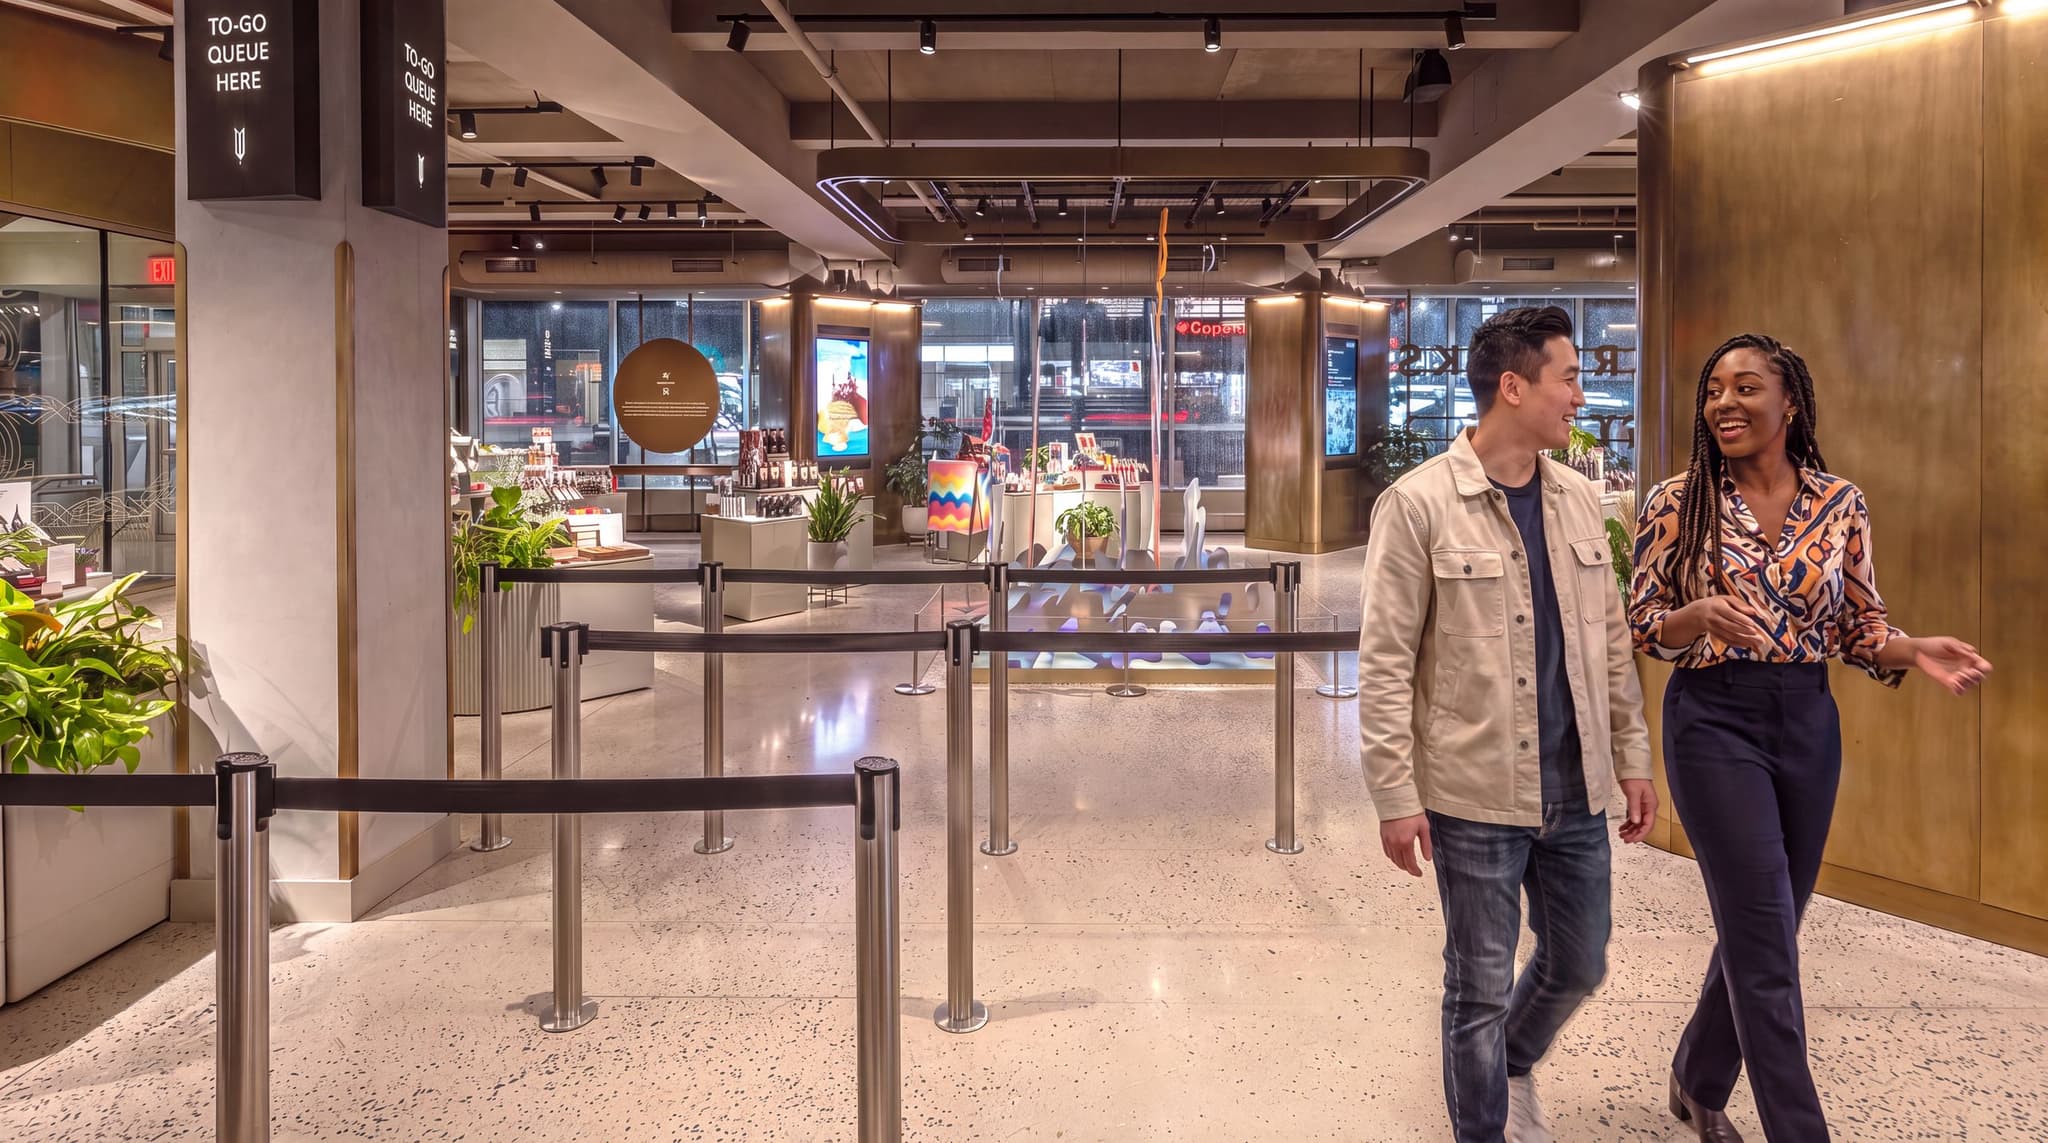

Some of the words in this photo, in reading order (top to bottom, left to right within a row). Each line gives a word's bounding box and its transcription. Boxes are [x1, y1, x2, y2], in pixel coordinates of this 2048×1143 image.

[208, 14, 267, 36] TO-GO
[208, 42, 269, 64] QUEUE
[404, 43, 435, 80] TO-GO
[216, 71, 261, 92] HERE
[404, 72, 436, 106] QUEUE
[408, 99, 433, 128] HERE
